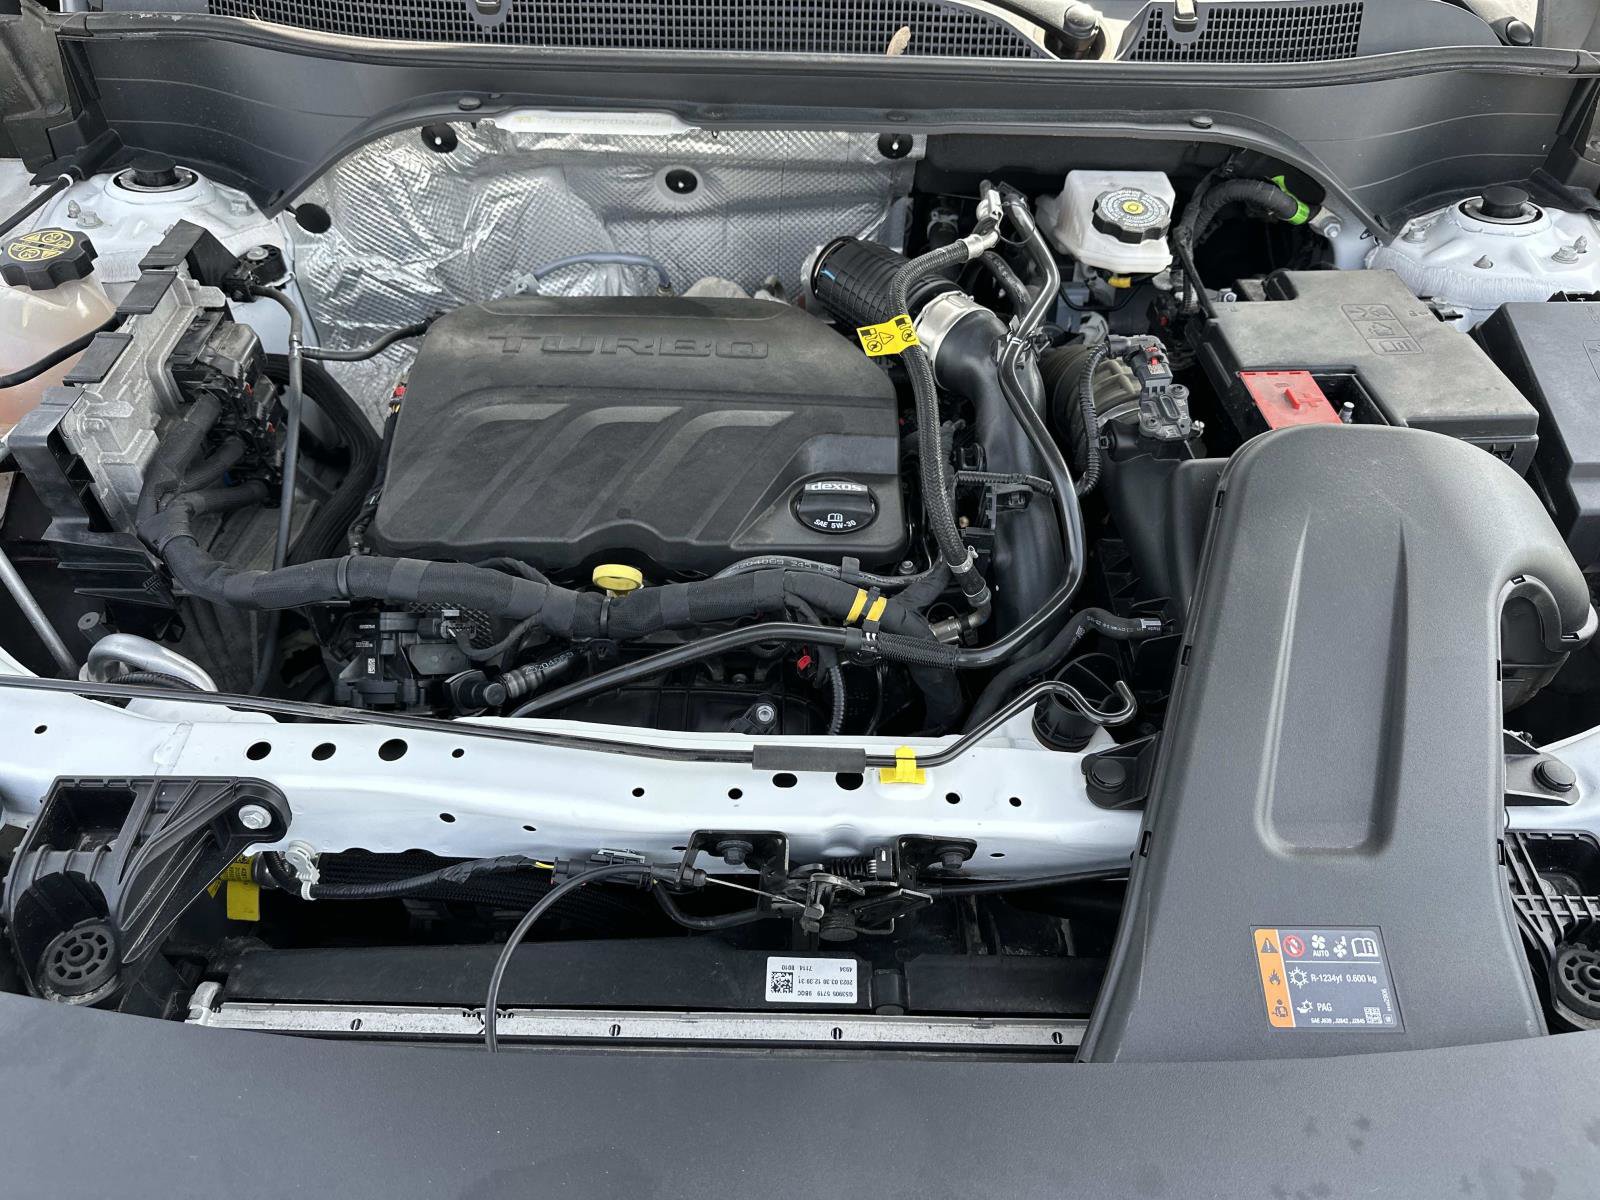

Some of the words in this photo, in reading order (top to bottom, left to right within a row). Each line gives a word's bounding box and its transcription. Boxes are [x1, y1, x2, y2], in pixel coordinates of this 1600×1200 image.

[488, 335, 769, 360] TURBO
[811, 482, 862, 492] dexos
[813, 519, 828, 528] SAE
[831, 519, 857, 529] 5W-30
[1310, 974, 1343, 984] R-1234yf
[1346, 974, 1367, 983] 0.600
[1367, 974, 1377, 984] kg
[1316, 1003, 1333, 1012] PAG
